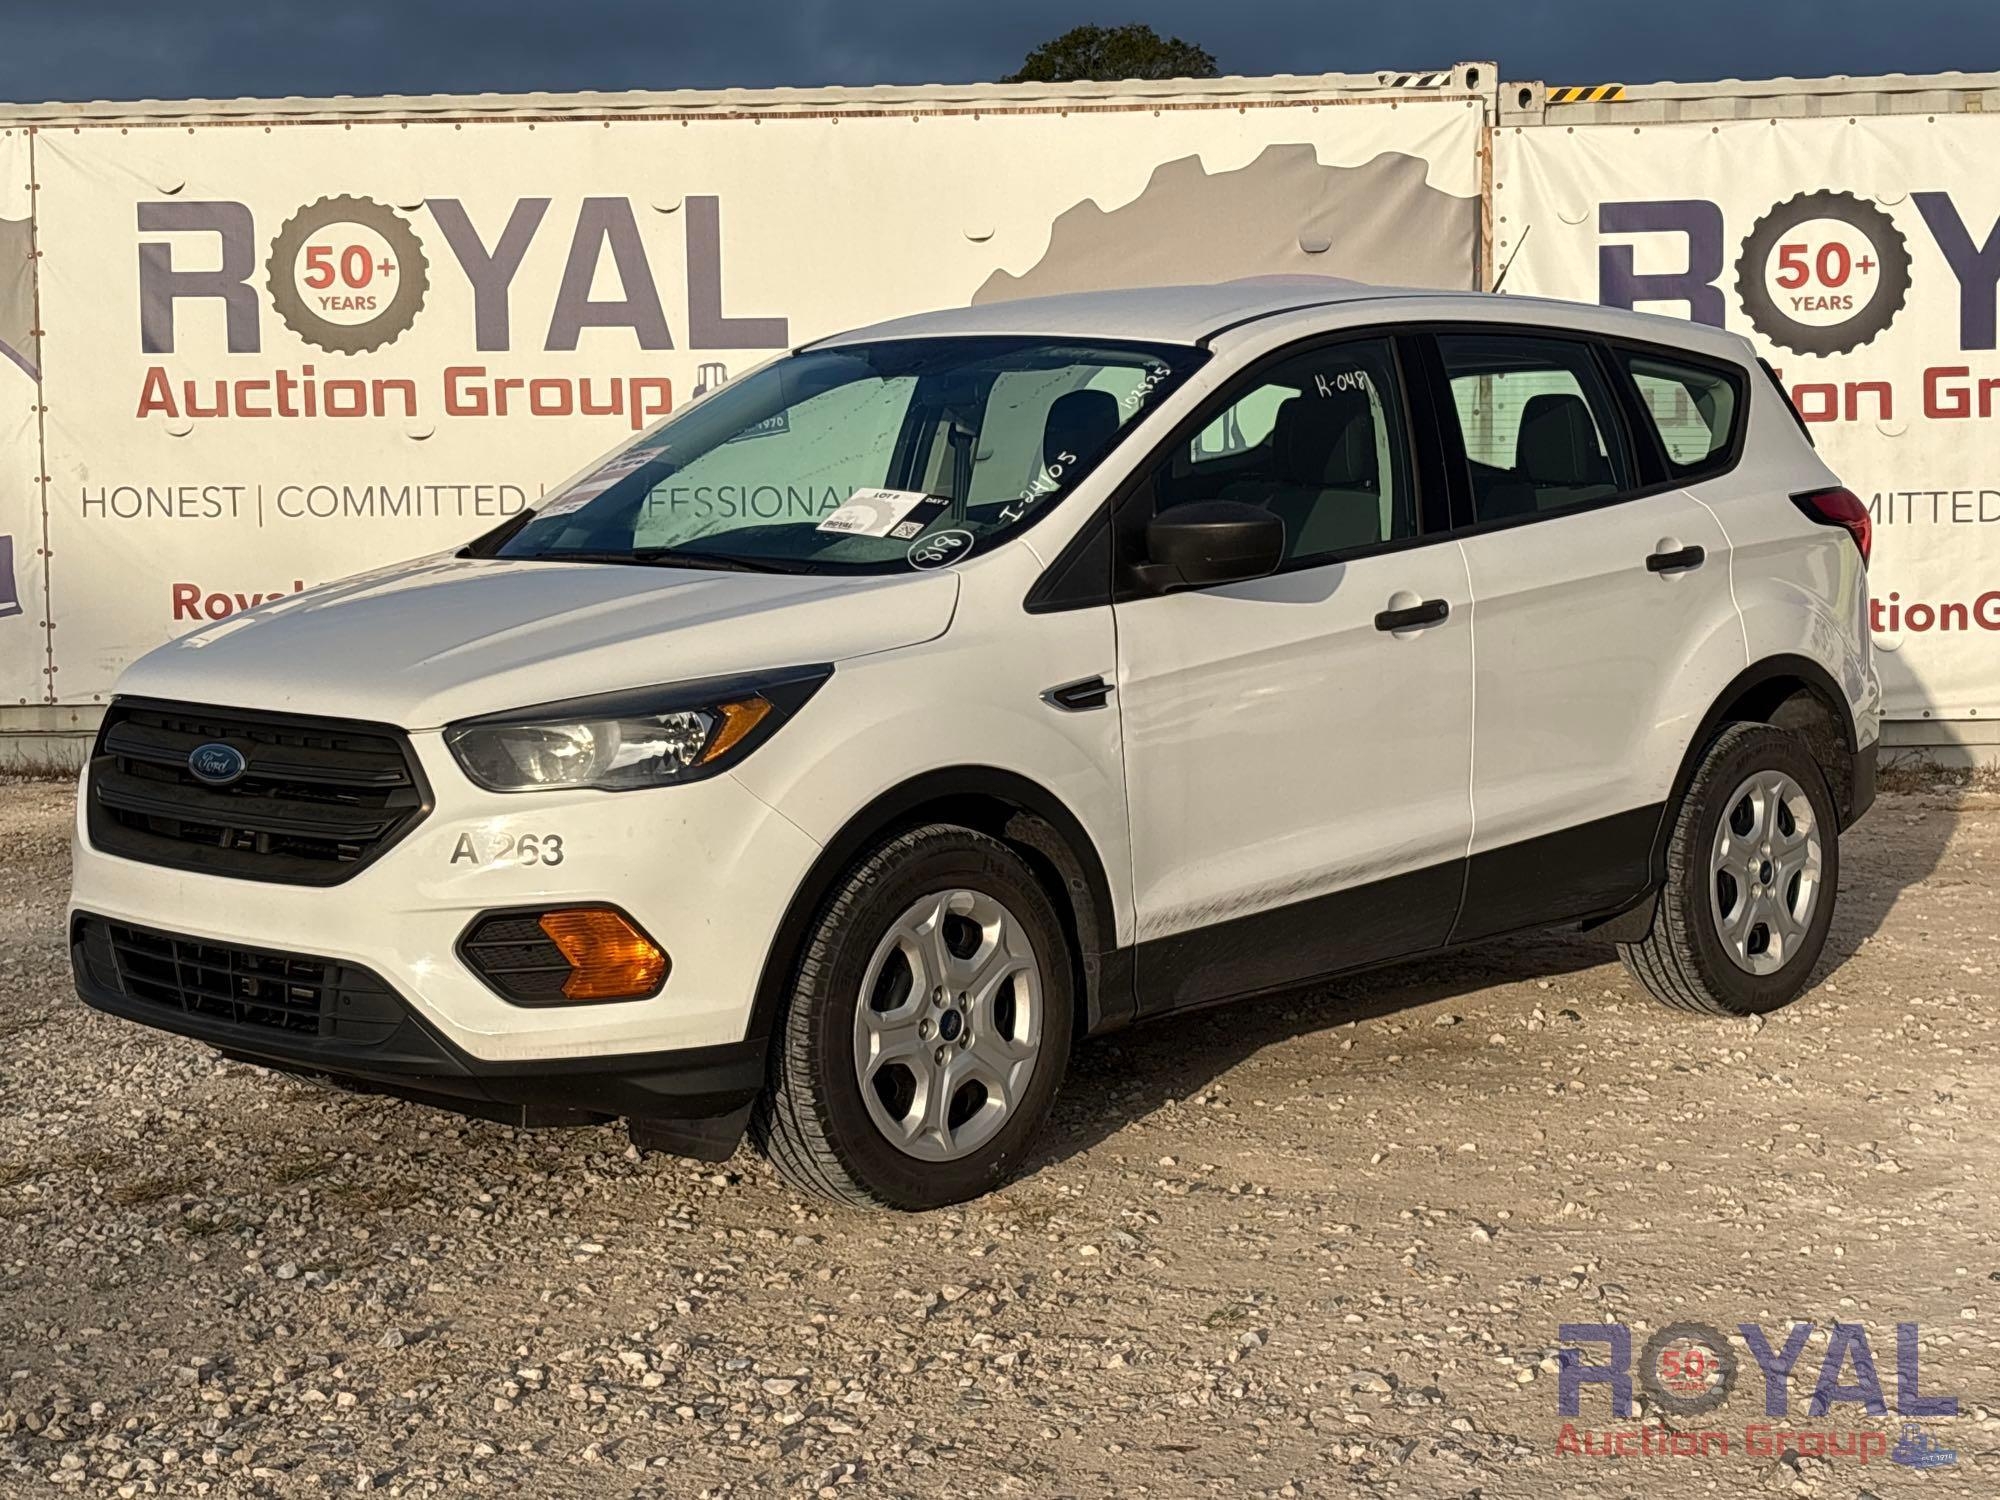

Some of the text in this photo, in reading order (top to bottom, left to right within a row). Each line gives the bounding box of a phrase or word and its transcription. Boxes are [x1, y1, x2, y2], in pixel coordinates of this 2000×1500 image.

[137, 193, 789, 356] ROYAL
[304, 244, 396, 290] 50+
[1775, 241, 1876, 290] 50+
[318, 296, 377, 311] YEARS
[1790, 295, 1853, 312] YEARS
[136, 364, 673, 431] Auction Group
[82, 486, 246, 519] HONEST
[276, 485, 526, 518] COMMITTED
[874, 492, 893, 500] LOT
[925, 497, 943, 505] DAY
[198, 749, 230, 774] Ford
[450, 832, 564, 867] A 263
